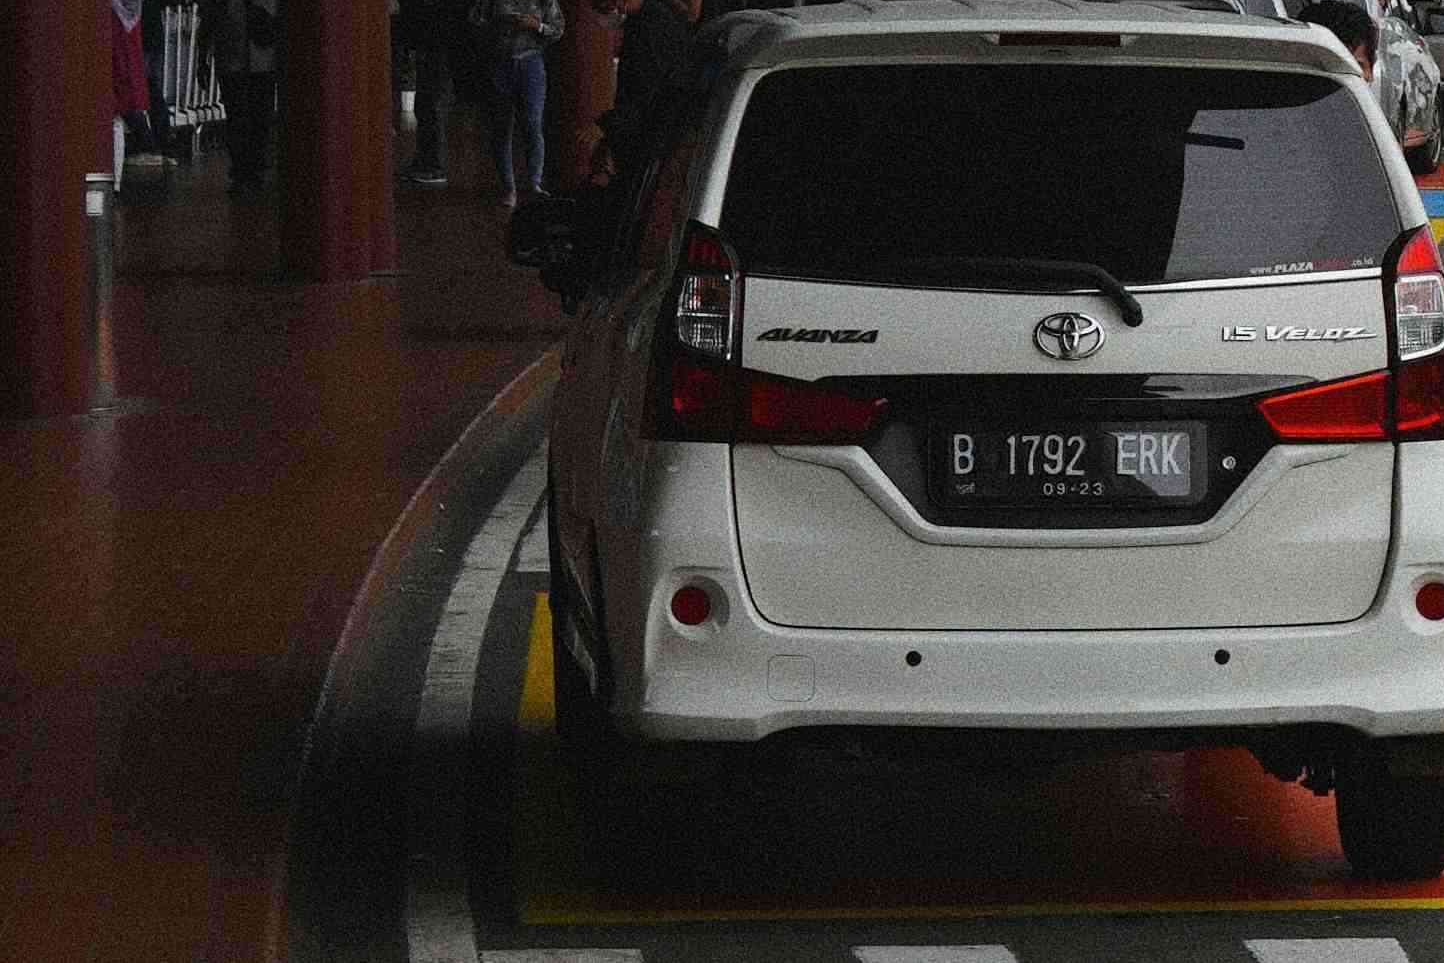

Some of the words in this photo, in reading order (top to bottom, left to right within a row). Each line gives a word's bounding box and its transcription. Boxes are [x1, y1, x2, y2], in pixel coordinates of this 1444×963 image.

[755, 327, 880, 345] AVANZA
[953, 432, 975, 476] B
[1006, 433, 1088, 476] 1792
[1115, 432, 1184, 476] ERK
